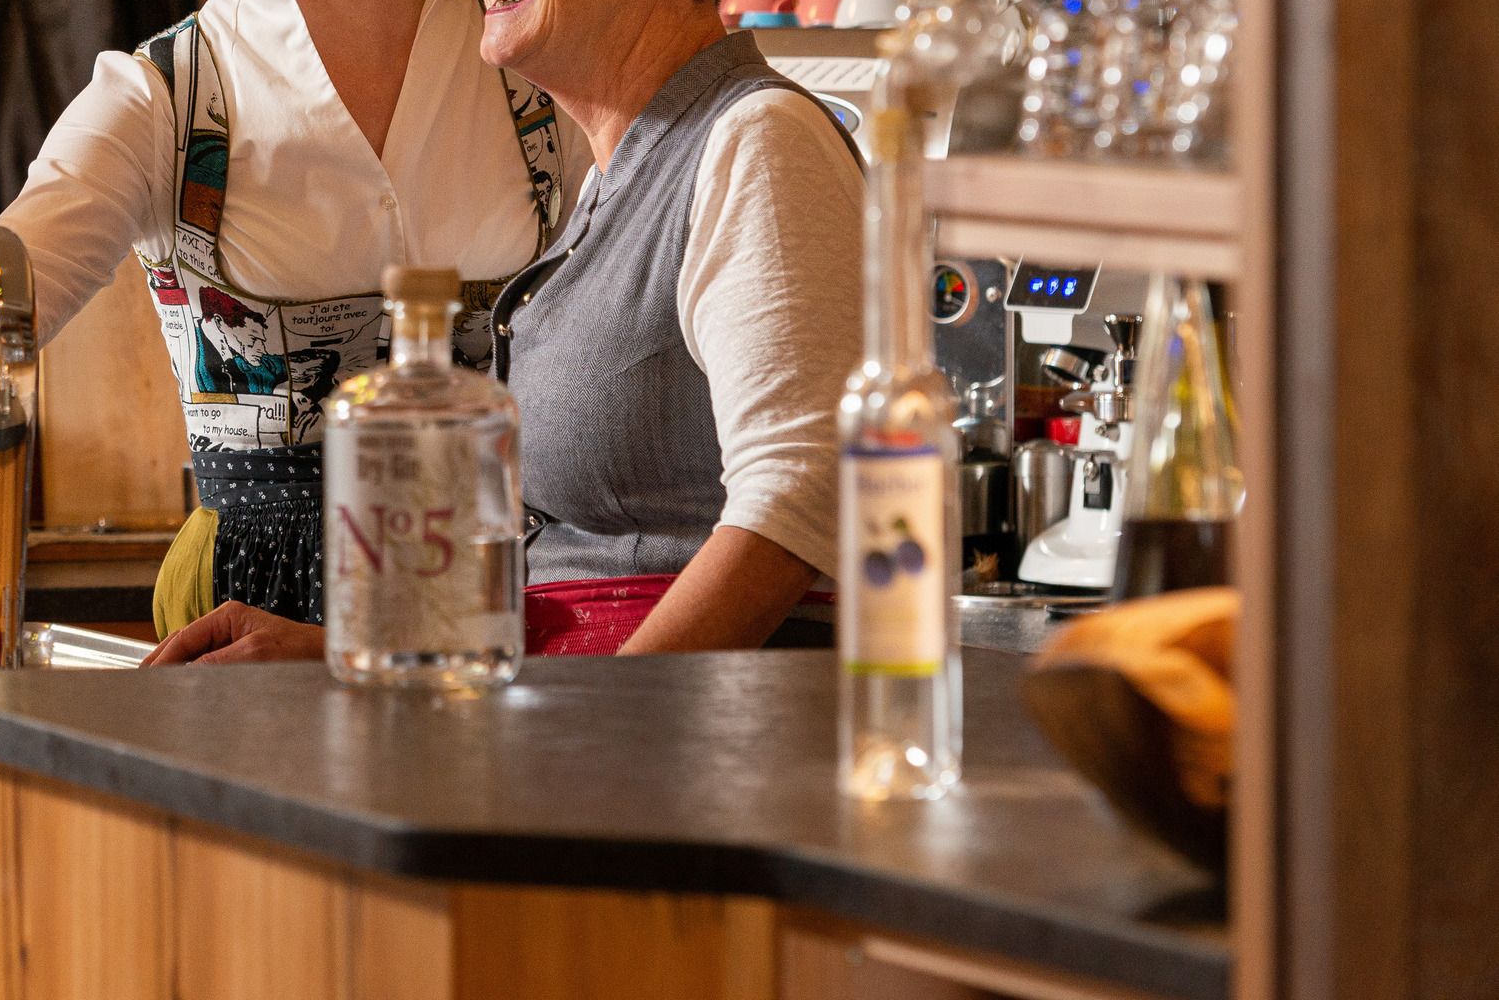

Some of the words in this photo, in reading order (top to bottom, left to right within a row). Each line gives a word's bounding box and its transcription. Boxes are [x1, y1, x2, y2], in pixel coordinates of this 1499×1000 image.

[178, 248, 189, 260] to
[190, 254, 205, 271] this
[208, 265, 223, 281] CA
[310, 304, 330, 315] J'ai
[292, 313, 341, 326] toutjours
[344, 310, 367, 320] avec
[200, 408, 209, 417] to
[211, 409, 221, 420] go
[203, 424, 211, 434] to
[212, 426, 223, 435] my
